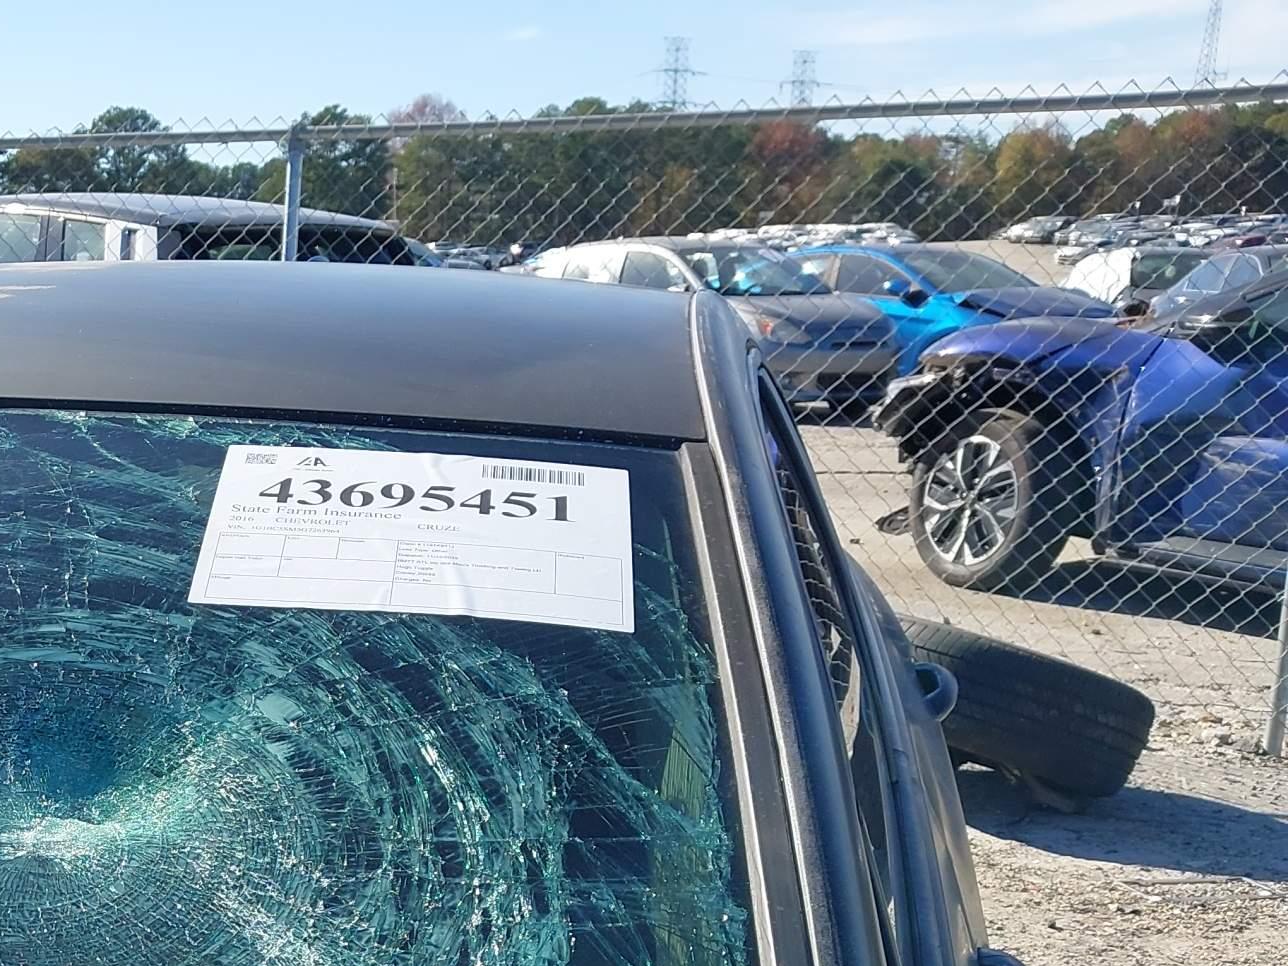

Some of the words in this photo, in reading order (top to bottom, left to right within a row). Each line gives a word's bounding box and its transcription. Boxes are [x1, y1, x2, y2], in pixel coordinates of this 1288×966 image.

[258, 477, 577, 523] 43695451
[231, 503, 271, 514] State
[276, 505, 317, 516] Farm
[324, 507, 402, 520] Insurance
[275, 517, 351, 527] CHEVROLET
[417, 523, 461, 532] CRUZE
